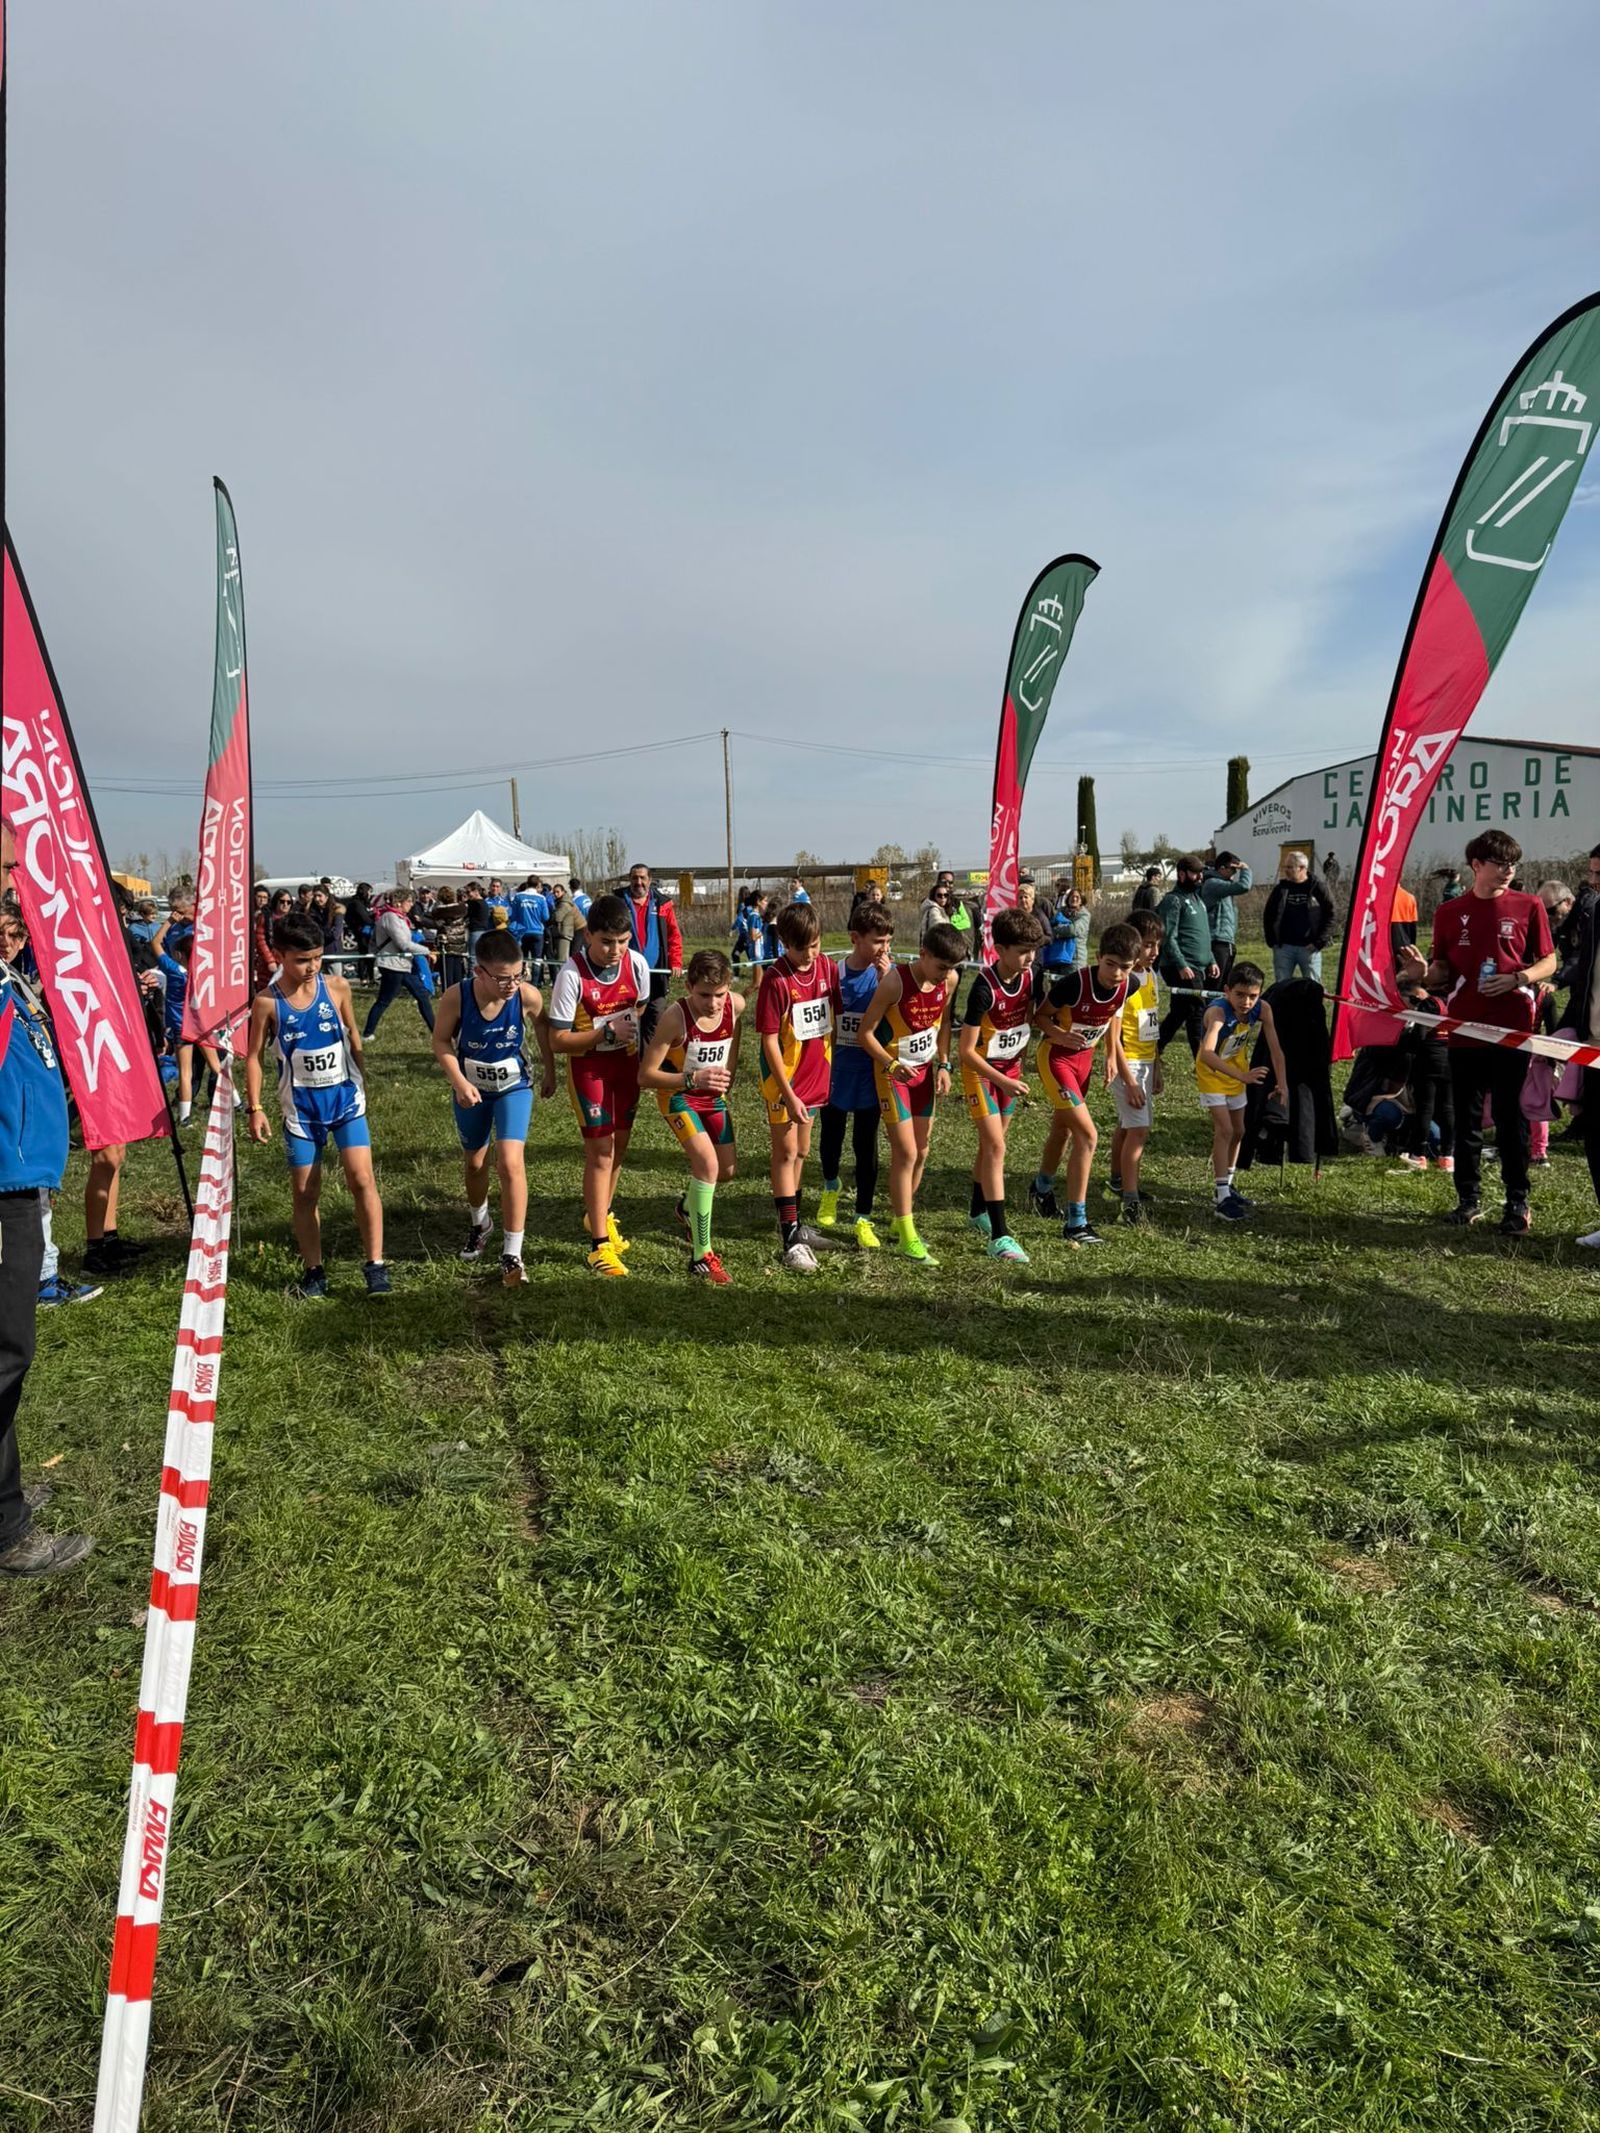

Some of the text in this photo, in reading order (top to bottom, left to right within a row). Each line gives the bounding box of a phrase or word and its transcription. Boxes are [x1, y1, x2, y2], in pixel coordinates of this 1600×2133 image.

[1324, 755, 1572, 798] CERO DE
[1253, 803, 1292, 824] VIVEROS
[1323, 789, 1570, 828] JAINERIA
[803, 1002, 826, 1024] 554
[841, 1016, 861, 1033] 55
[909, 1032, 933, 1054] 555
[998, 1030, 1023, 1049] 557
[303, 1051, 337, 1073] 552
[697, 1045, 725, 1063] 558
[475, 1066, 509, 1081] 553
